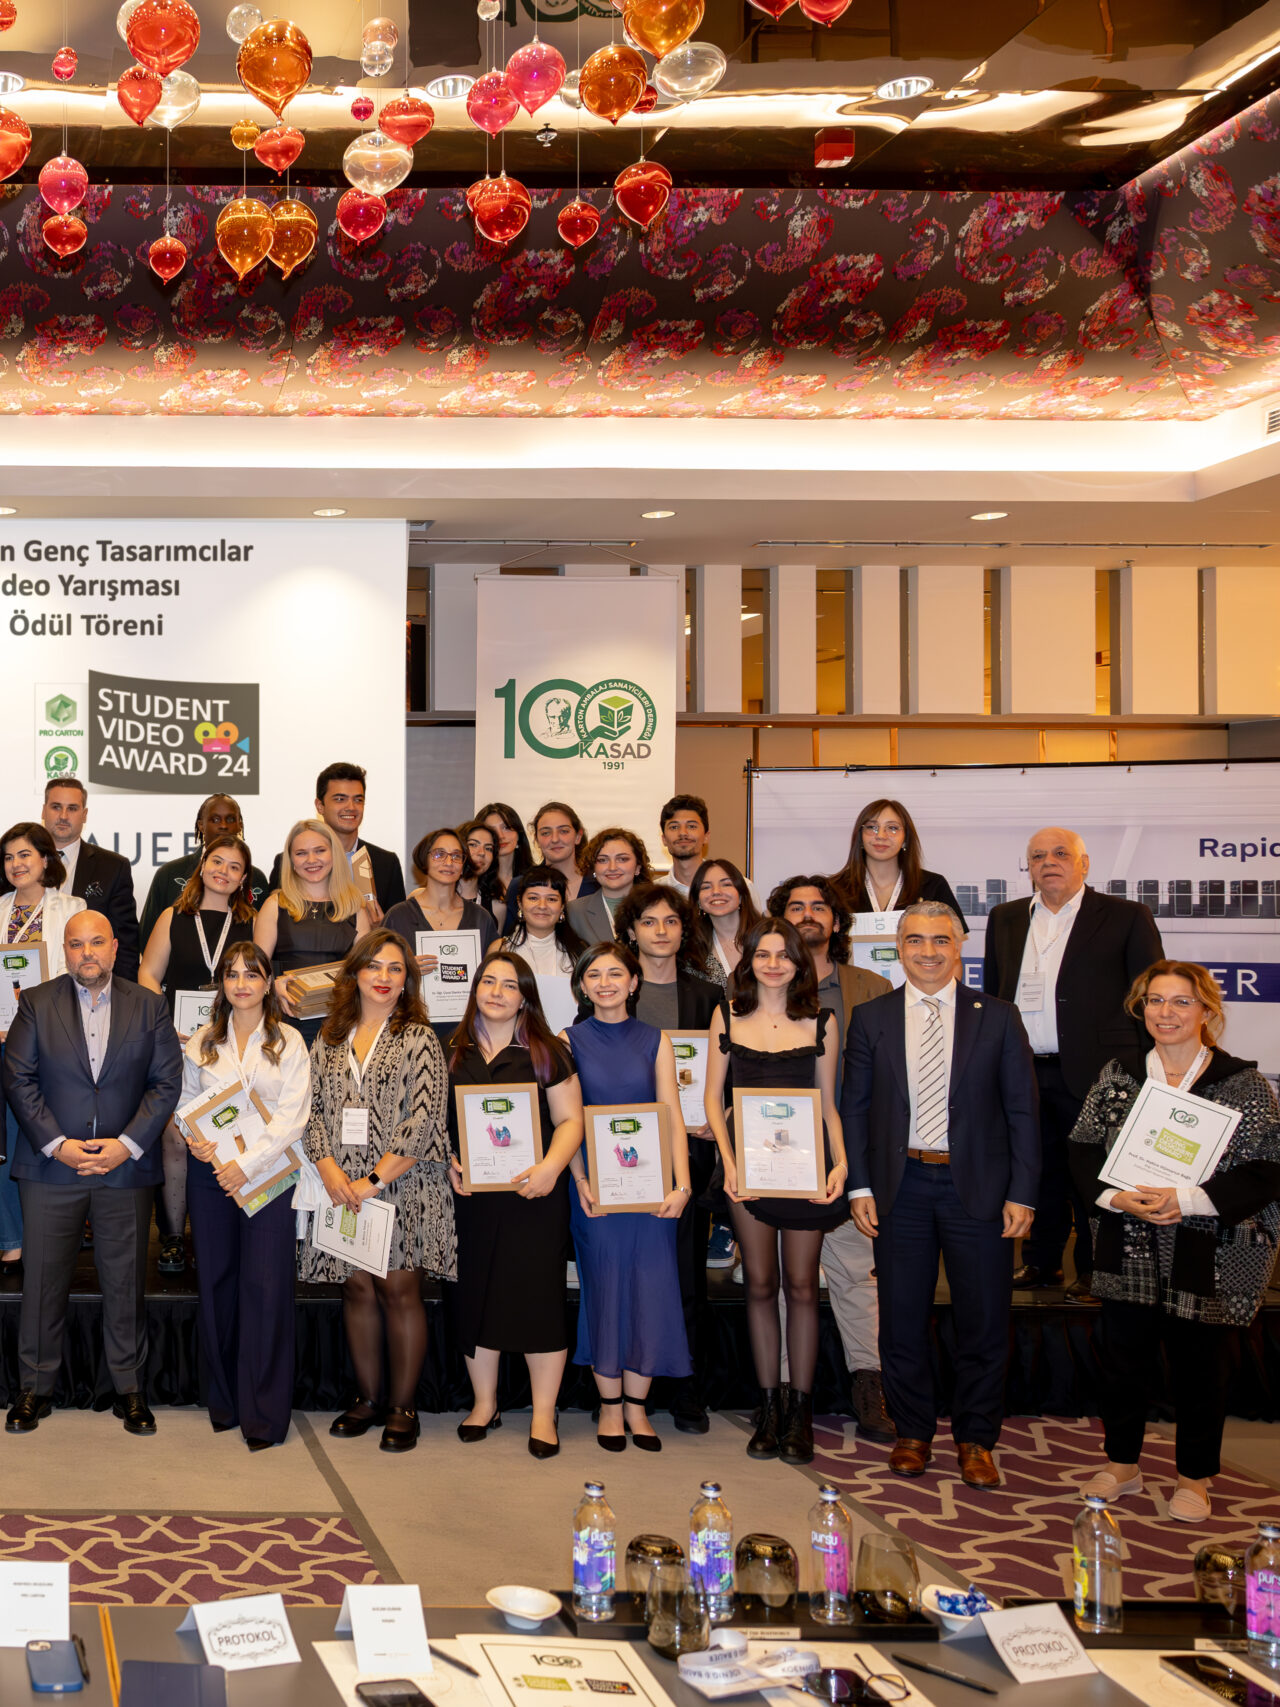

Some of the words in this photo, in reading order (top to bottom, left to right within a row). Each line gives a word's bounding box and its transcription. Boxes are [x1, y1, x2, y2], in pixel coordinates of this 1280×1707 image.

[23, 540, 89, 567] Genç
[96, 539, 253, 562] Tasarımcılar
[58, 574, 180, 601] Yarışması
[9, 609, 72, 636] Ödül
[80, 613, 163, 636] Töreni
[98, 688, 230, 722] STUDENT
[582, 683, 608, 709] AMBALAJ
[39, 729, 54, 737] PRO
[55, 729, 84, 737] CARTON
[97, 714, 185, 748] VIDEO
[577, 709, 588, 739] KARTON
[98, 744, 208, 776] AWARD
[579, 742, 652, 759] KASAD
[602, 761, 625, 770] 1991
[811, 1530, 838, 1546] pursu
[217, 1629, 278, 1648] PROTOKOL
[1012, 1640, 1069, 1658] PROTOKOL
